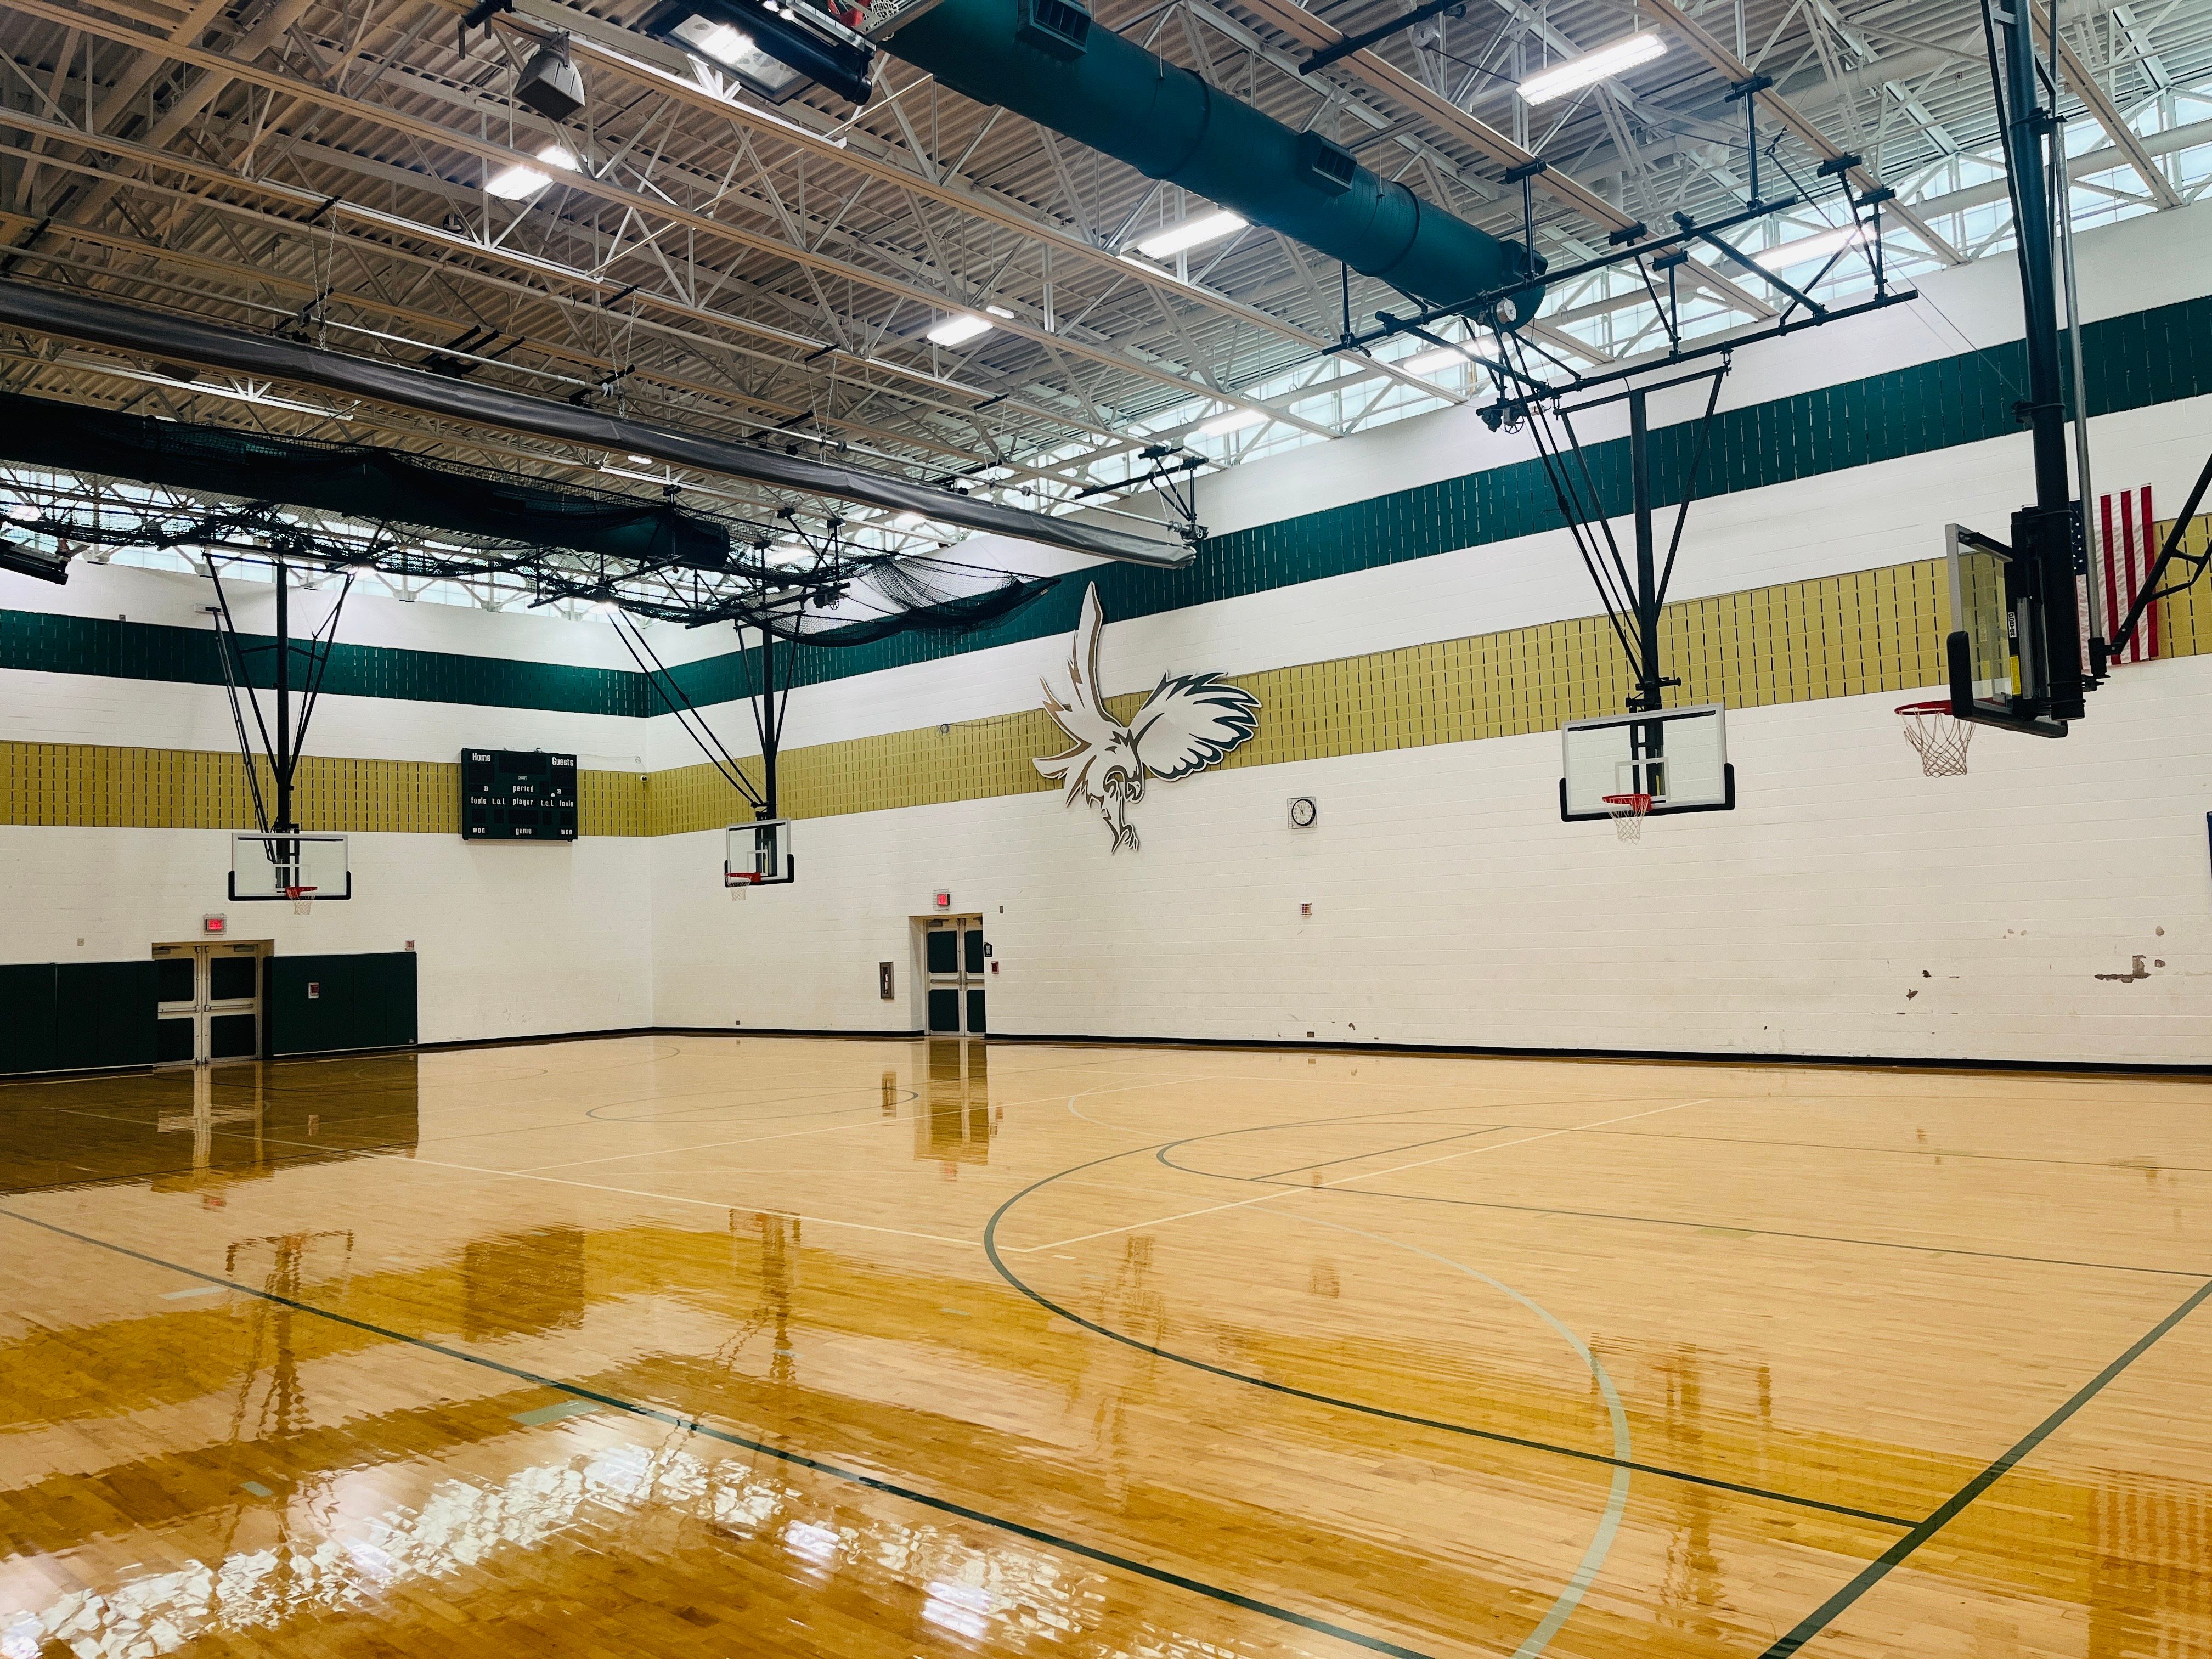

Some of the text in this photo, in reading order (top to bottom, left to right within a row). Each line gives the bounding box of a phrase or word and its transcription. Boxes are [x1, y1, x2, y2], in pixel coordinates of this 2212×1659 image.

[472, 753, 490, 761] Home
[552, 757, 573, 766] Guests
[513, 798, 533, 806] player
